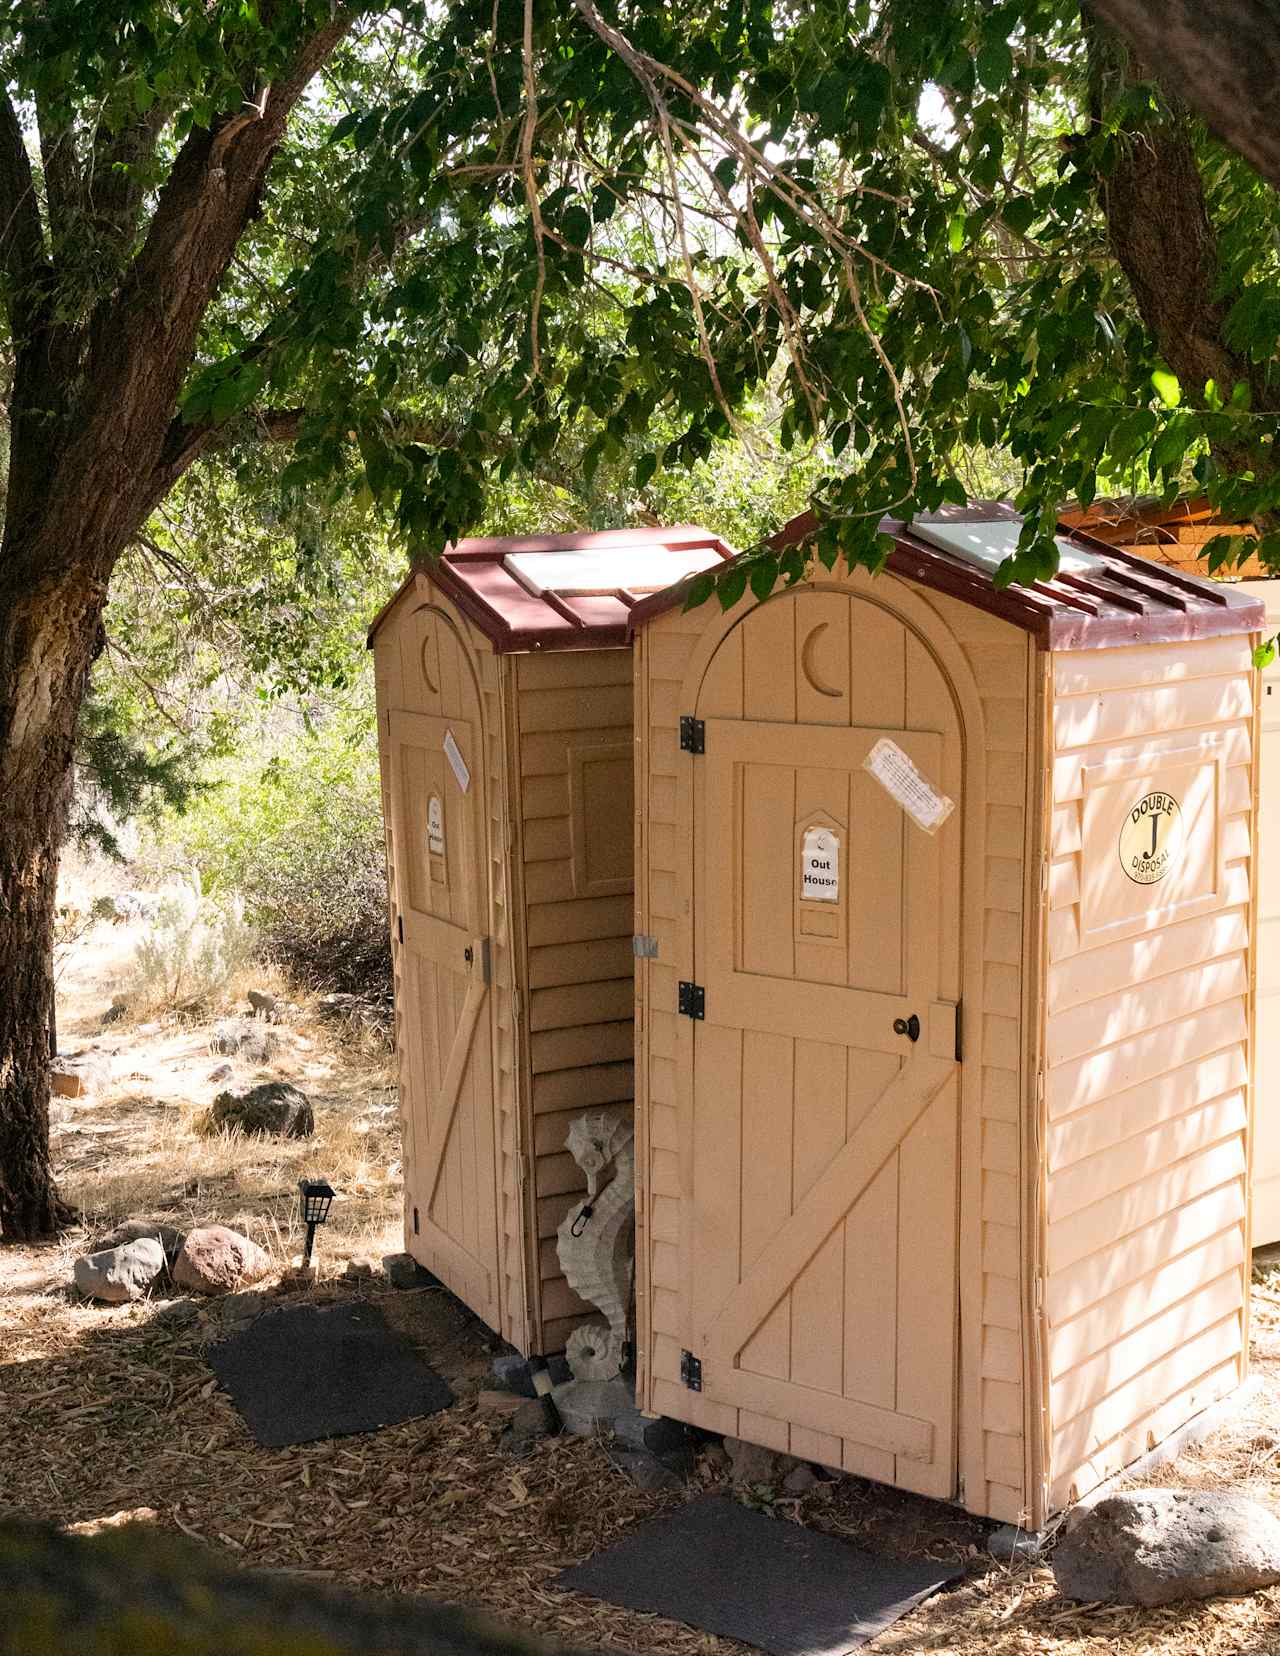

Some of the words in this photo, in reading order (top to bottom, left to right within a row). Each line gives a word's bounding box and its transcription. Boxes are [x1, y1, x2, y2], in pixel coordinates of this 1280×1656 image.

[1131, 795, 1174, 824] DOUBLE
[1143, 811, 1163, 860] J
[811, 859, 831, 870] Out
